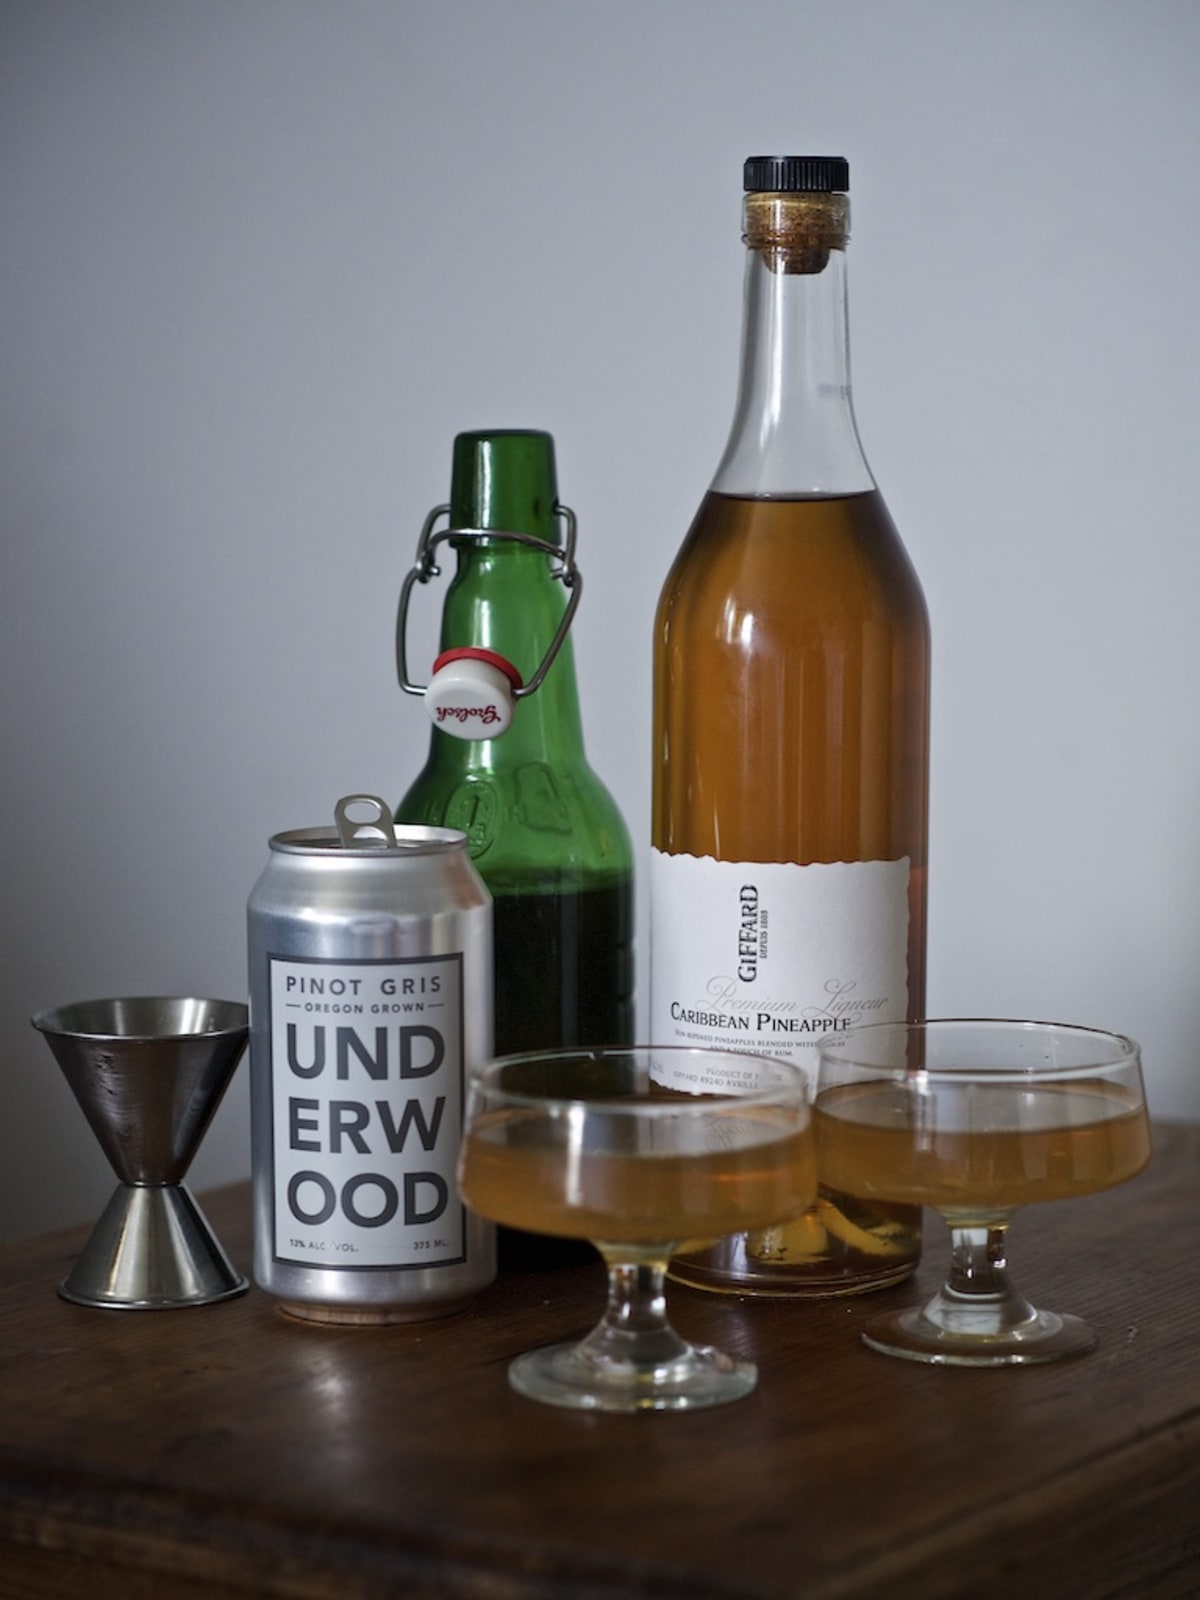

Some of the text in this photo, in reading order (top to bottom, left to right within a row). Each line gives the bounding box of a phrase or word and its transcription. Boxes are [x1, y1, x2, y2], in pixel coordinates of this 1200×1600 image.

[436, 704, 502, 724] Grolsch
[737, 884, 759, 983] GIFFARD
[286, 976, 441, 996] PINOT GRIS
[304, 1002, 425, 1014] OREGON GROWN
[696, 975, 890, 1024] Premium Liqueur
[670, 1002, 851, 1032] CARIBBEAN PINEAPPLE
[286, 1022, 445, 1080] UND
[288, 1096, 447, 1154] ERW
[286, 1170, 449, 1228] OOD
